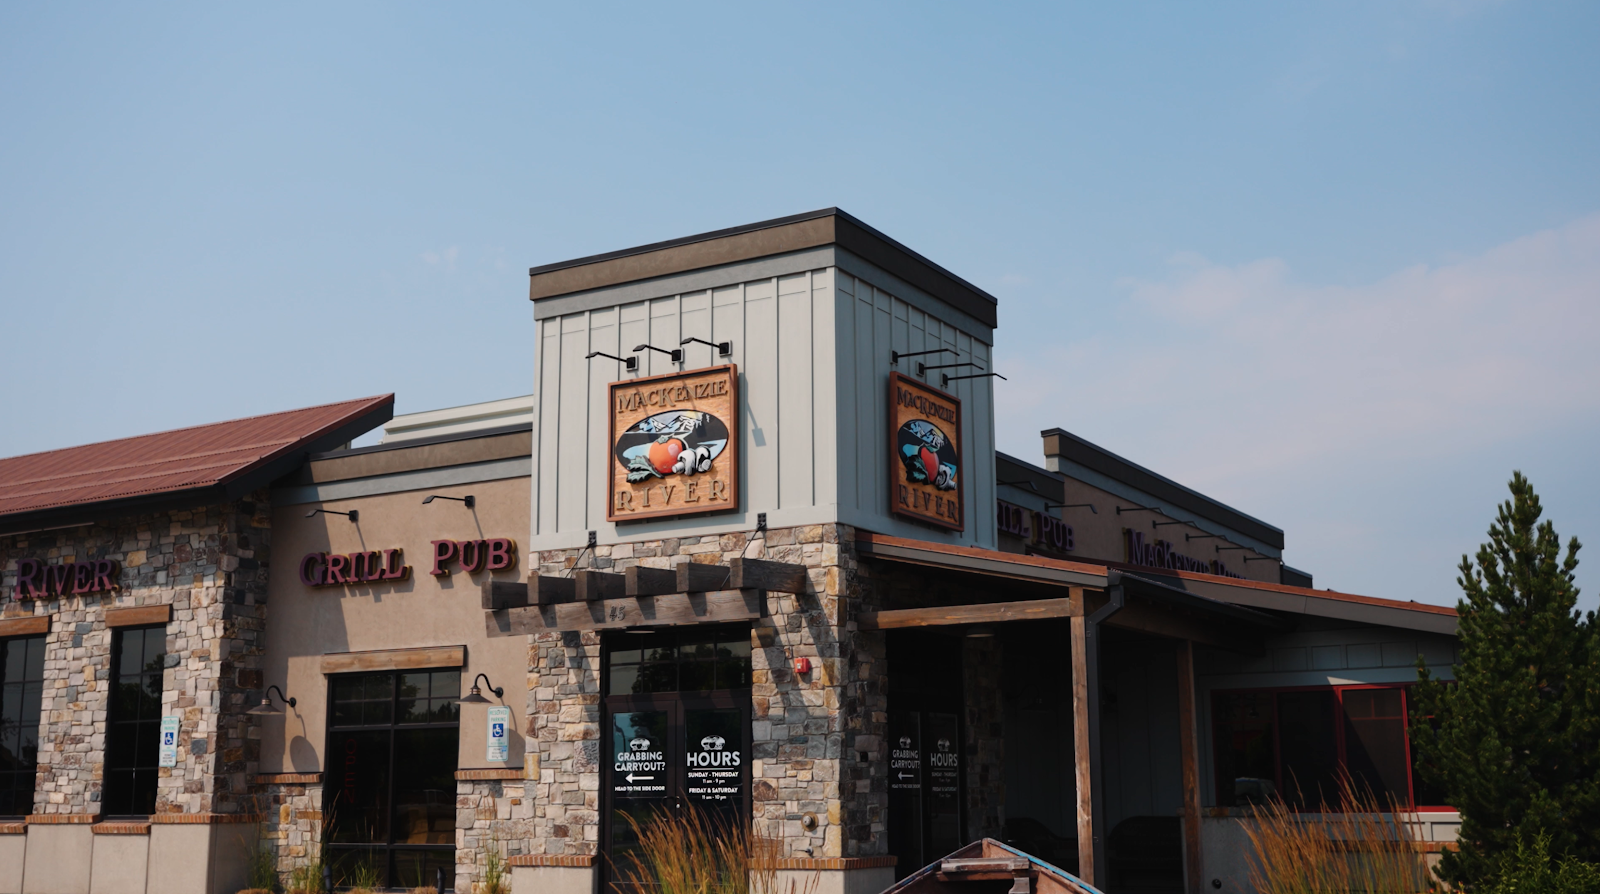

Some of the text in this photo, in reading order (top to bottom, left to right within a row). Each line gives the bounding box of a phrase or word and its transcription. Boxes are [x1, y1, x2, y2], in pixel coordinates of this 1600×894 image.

[617, 379, 728, 413] MACKENZIE
[897, 386, 956, 425] MACKENZIE
[616, 479, 728, 512] RIVER
[898, 484, 958, 523] RIVER
[997, 502, 1075, 551] ILL PUB
[13, 557, 119, 601] RIVER
[299, 537, 516, 588] GRILL PUB
[343, 738, 358, 804] OPEN
[614, 762, 666, 772] CARRYOUT?
[617, 752, 663, 761] GRABBING
[686, 751, 741, 767] HOURS
[930, 752, 958, 767] HOURS
